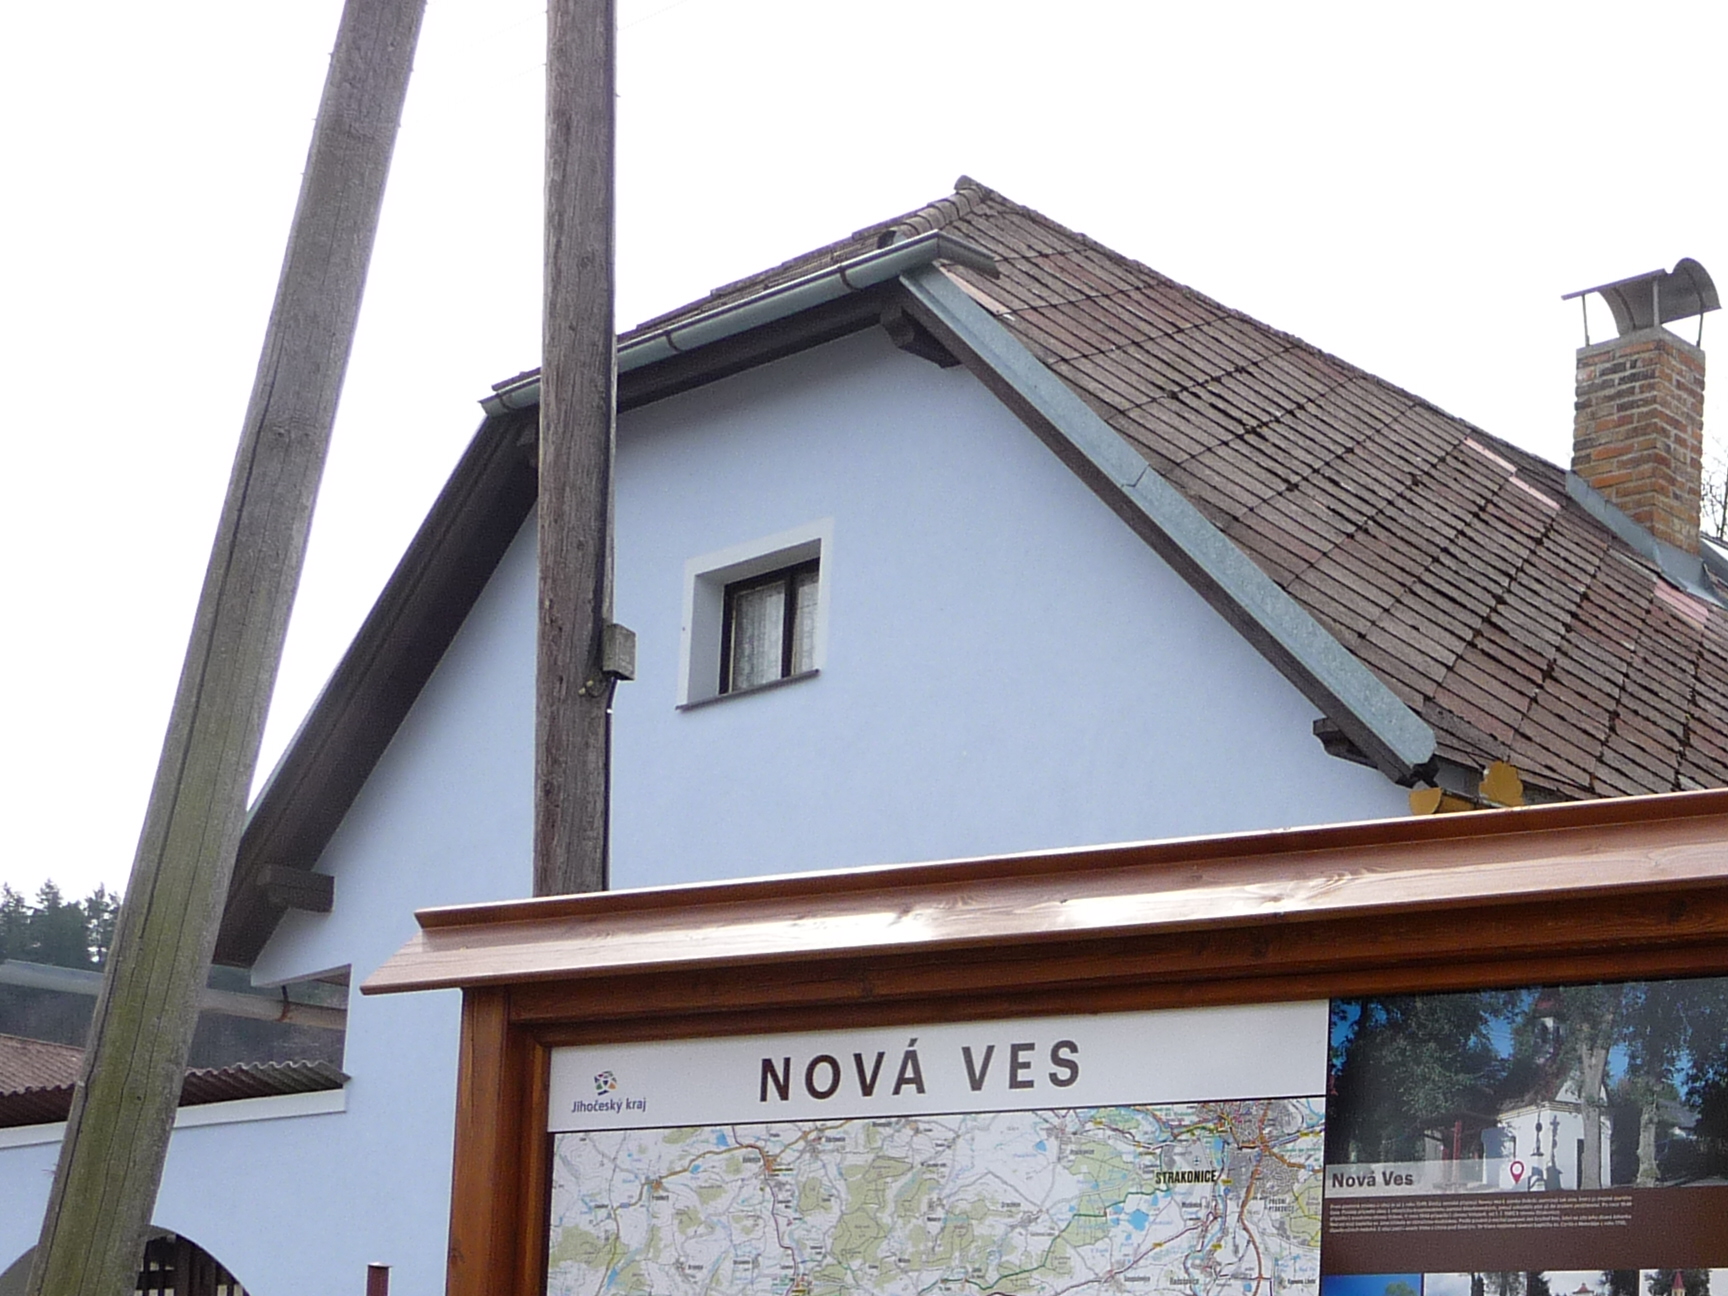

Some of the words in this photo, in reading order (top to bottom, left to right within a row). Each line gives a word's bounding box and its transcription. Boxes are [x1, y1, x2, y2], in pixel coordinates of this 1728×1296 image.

[759, 1037, 926, 1103] NOVÁ
[961, 1039, 1080, 1092] VES
[571, 1098, 622, 1114] Jihočeský
[625, 1097, 647, 1112] kraj
[1155, 1169, 1217, 1185] STRAKONICE
[1331, 1171, 1376, 1188] Nová
[1382, 1170, 1414, 1187] Ves
